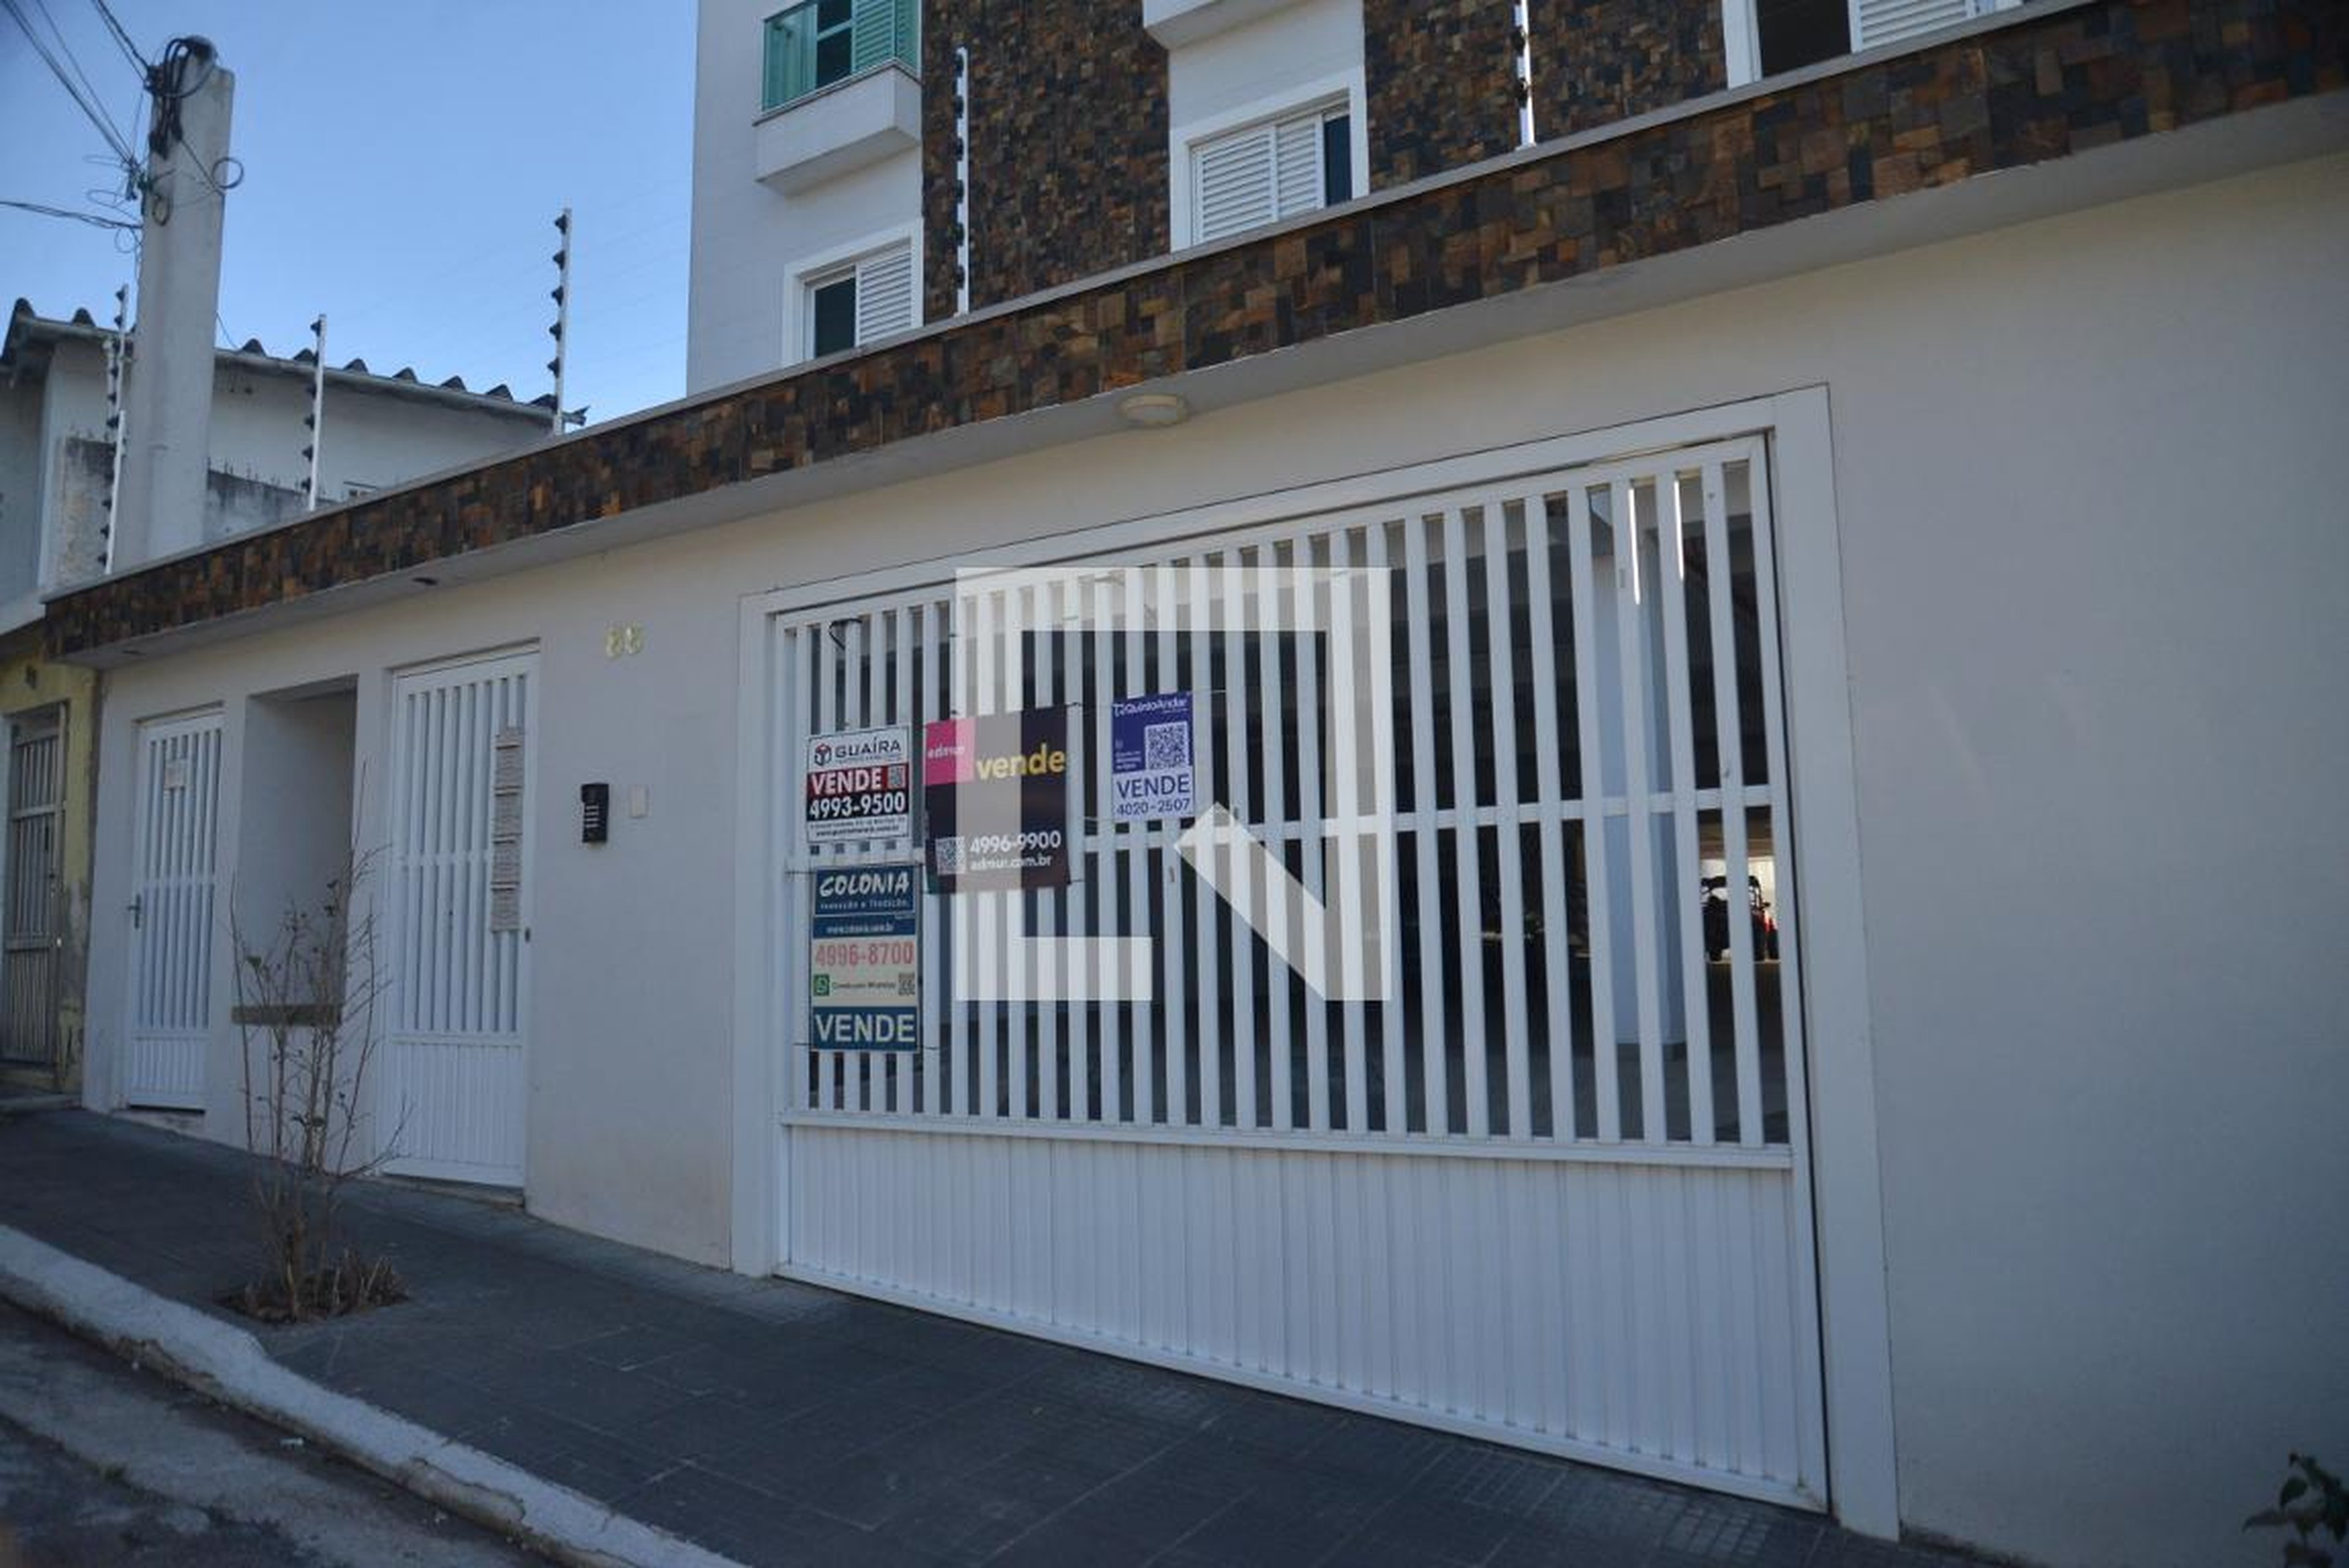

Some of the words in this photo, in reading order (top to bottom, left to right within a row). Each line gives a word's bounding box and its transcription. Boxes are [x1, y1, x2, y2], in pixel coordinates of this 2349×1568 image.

[835, 736, 901, 758] GUAÍRA
[976, 743, 1066, 780] vende
[811, 767, 883, 794] VENDE
[1116, 774, 1190, 799] VENDE
[809, 791, 905, 819] 4993-9500
[1116, 797, 1190, 816] 4020-2507
[970, 830, 1061, 854] 4996-9900
[819, 871, 910, 897] COLONIA
[815, 941, 914, 967] 4996-8700
[814, 1013, 916, 1042] VENDE
